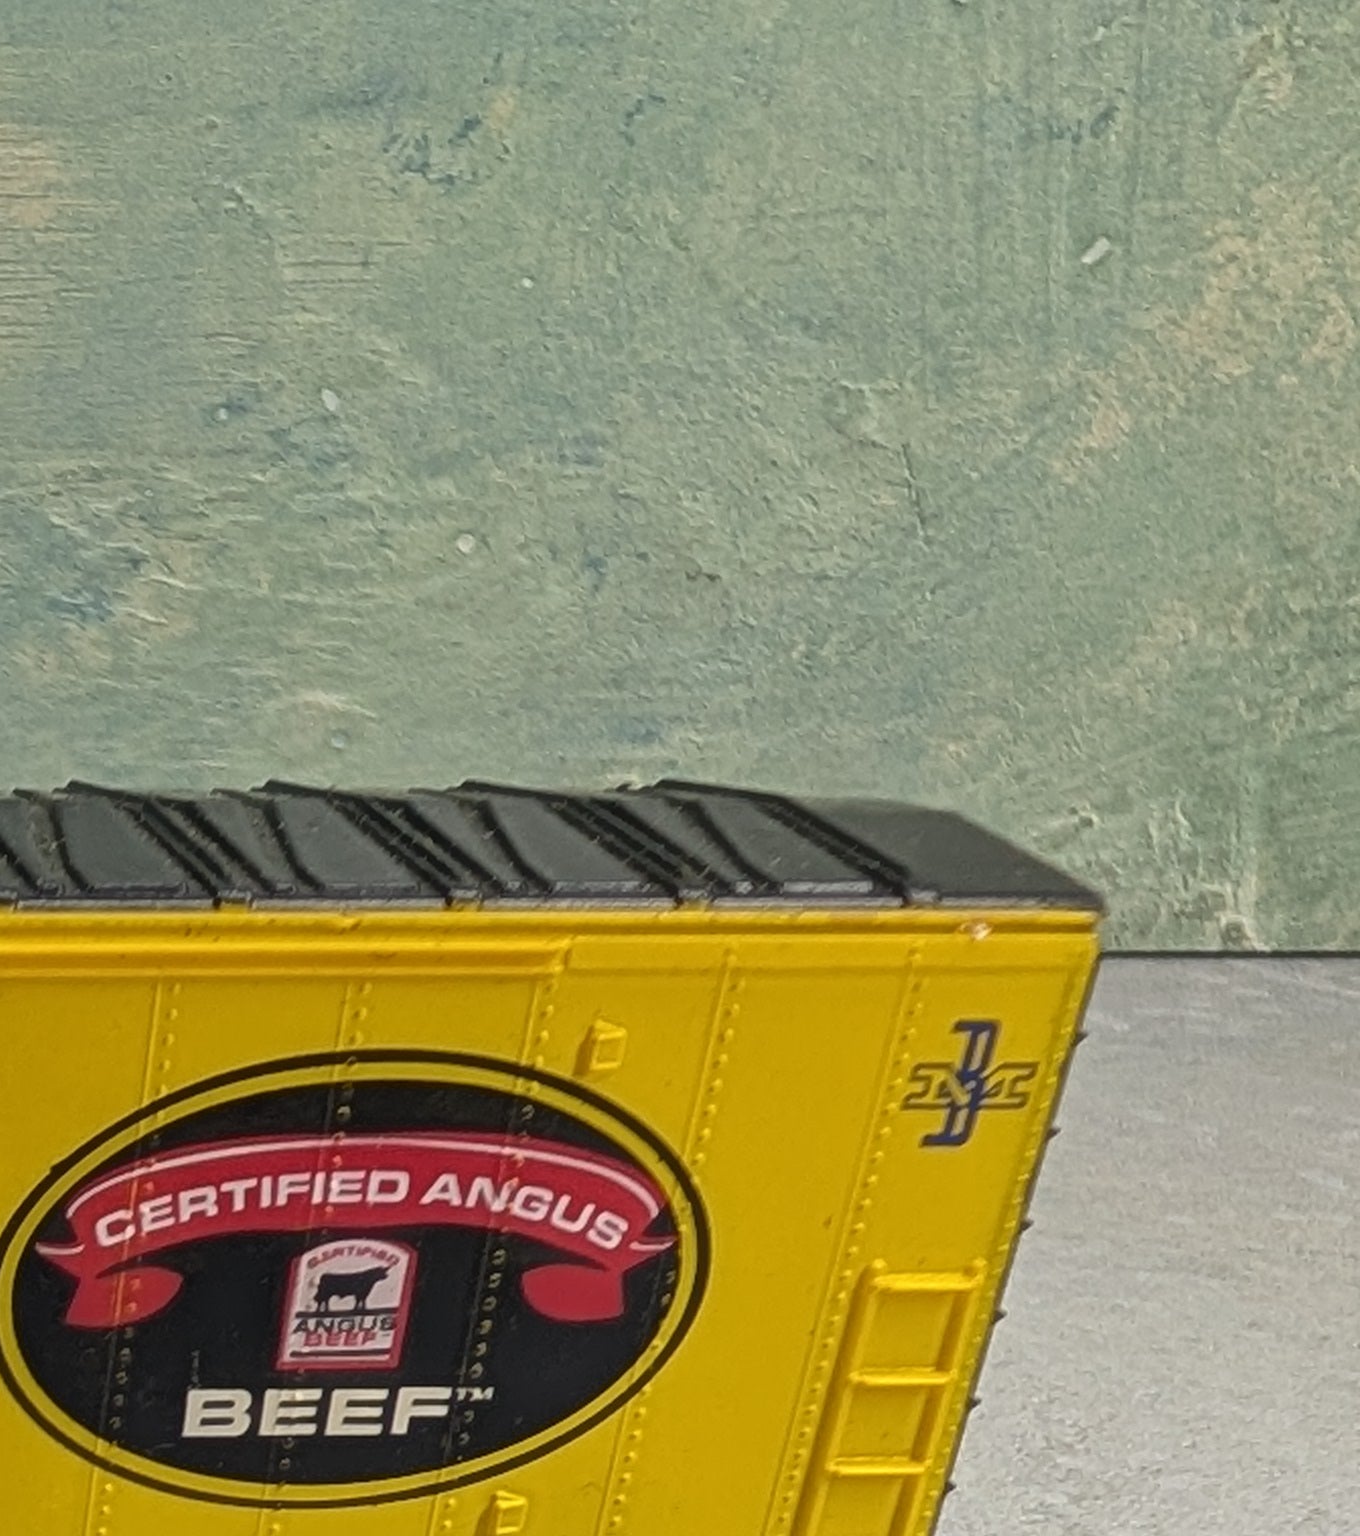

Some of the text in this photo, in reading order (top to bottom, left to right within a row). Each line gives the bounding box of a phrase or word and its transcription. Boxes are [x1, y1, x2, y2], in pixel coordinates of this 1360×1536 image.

[94, 1170, 630, 1251] CERTIFIED ANGUS
[292, 1315, 397, 1334] ANGUS
[303, 1331, 378, 1347] BEEF
